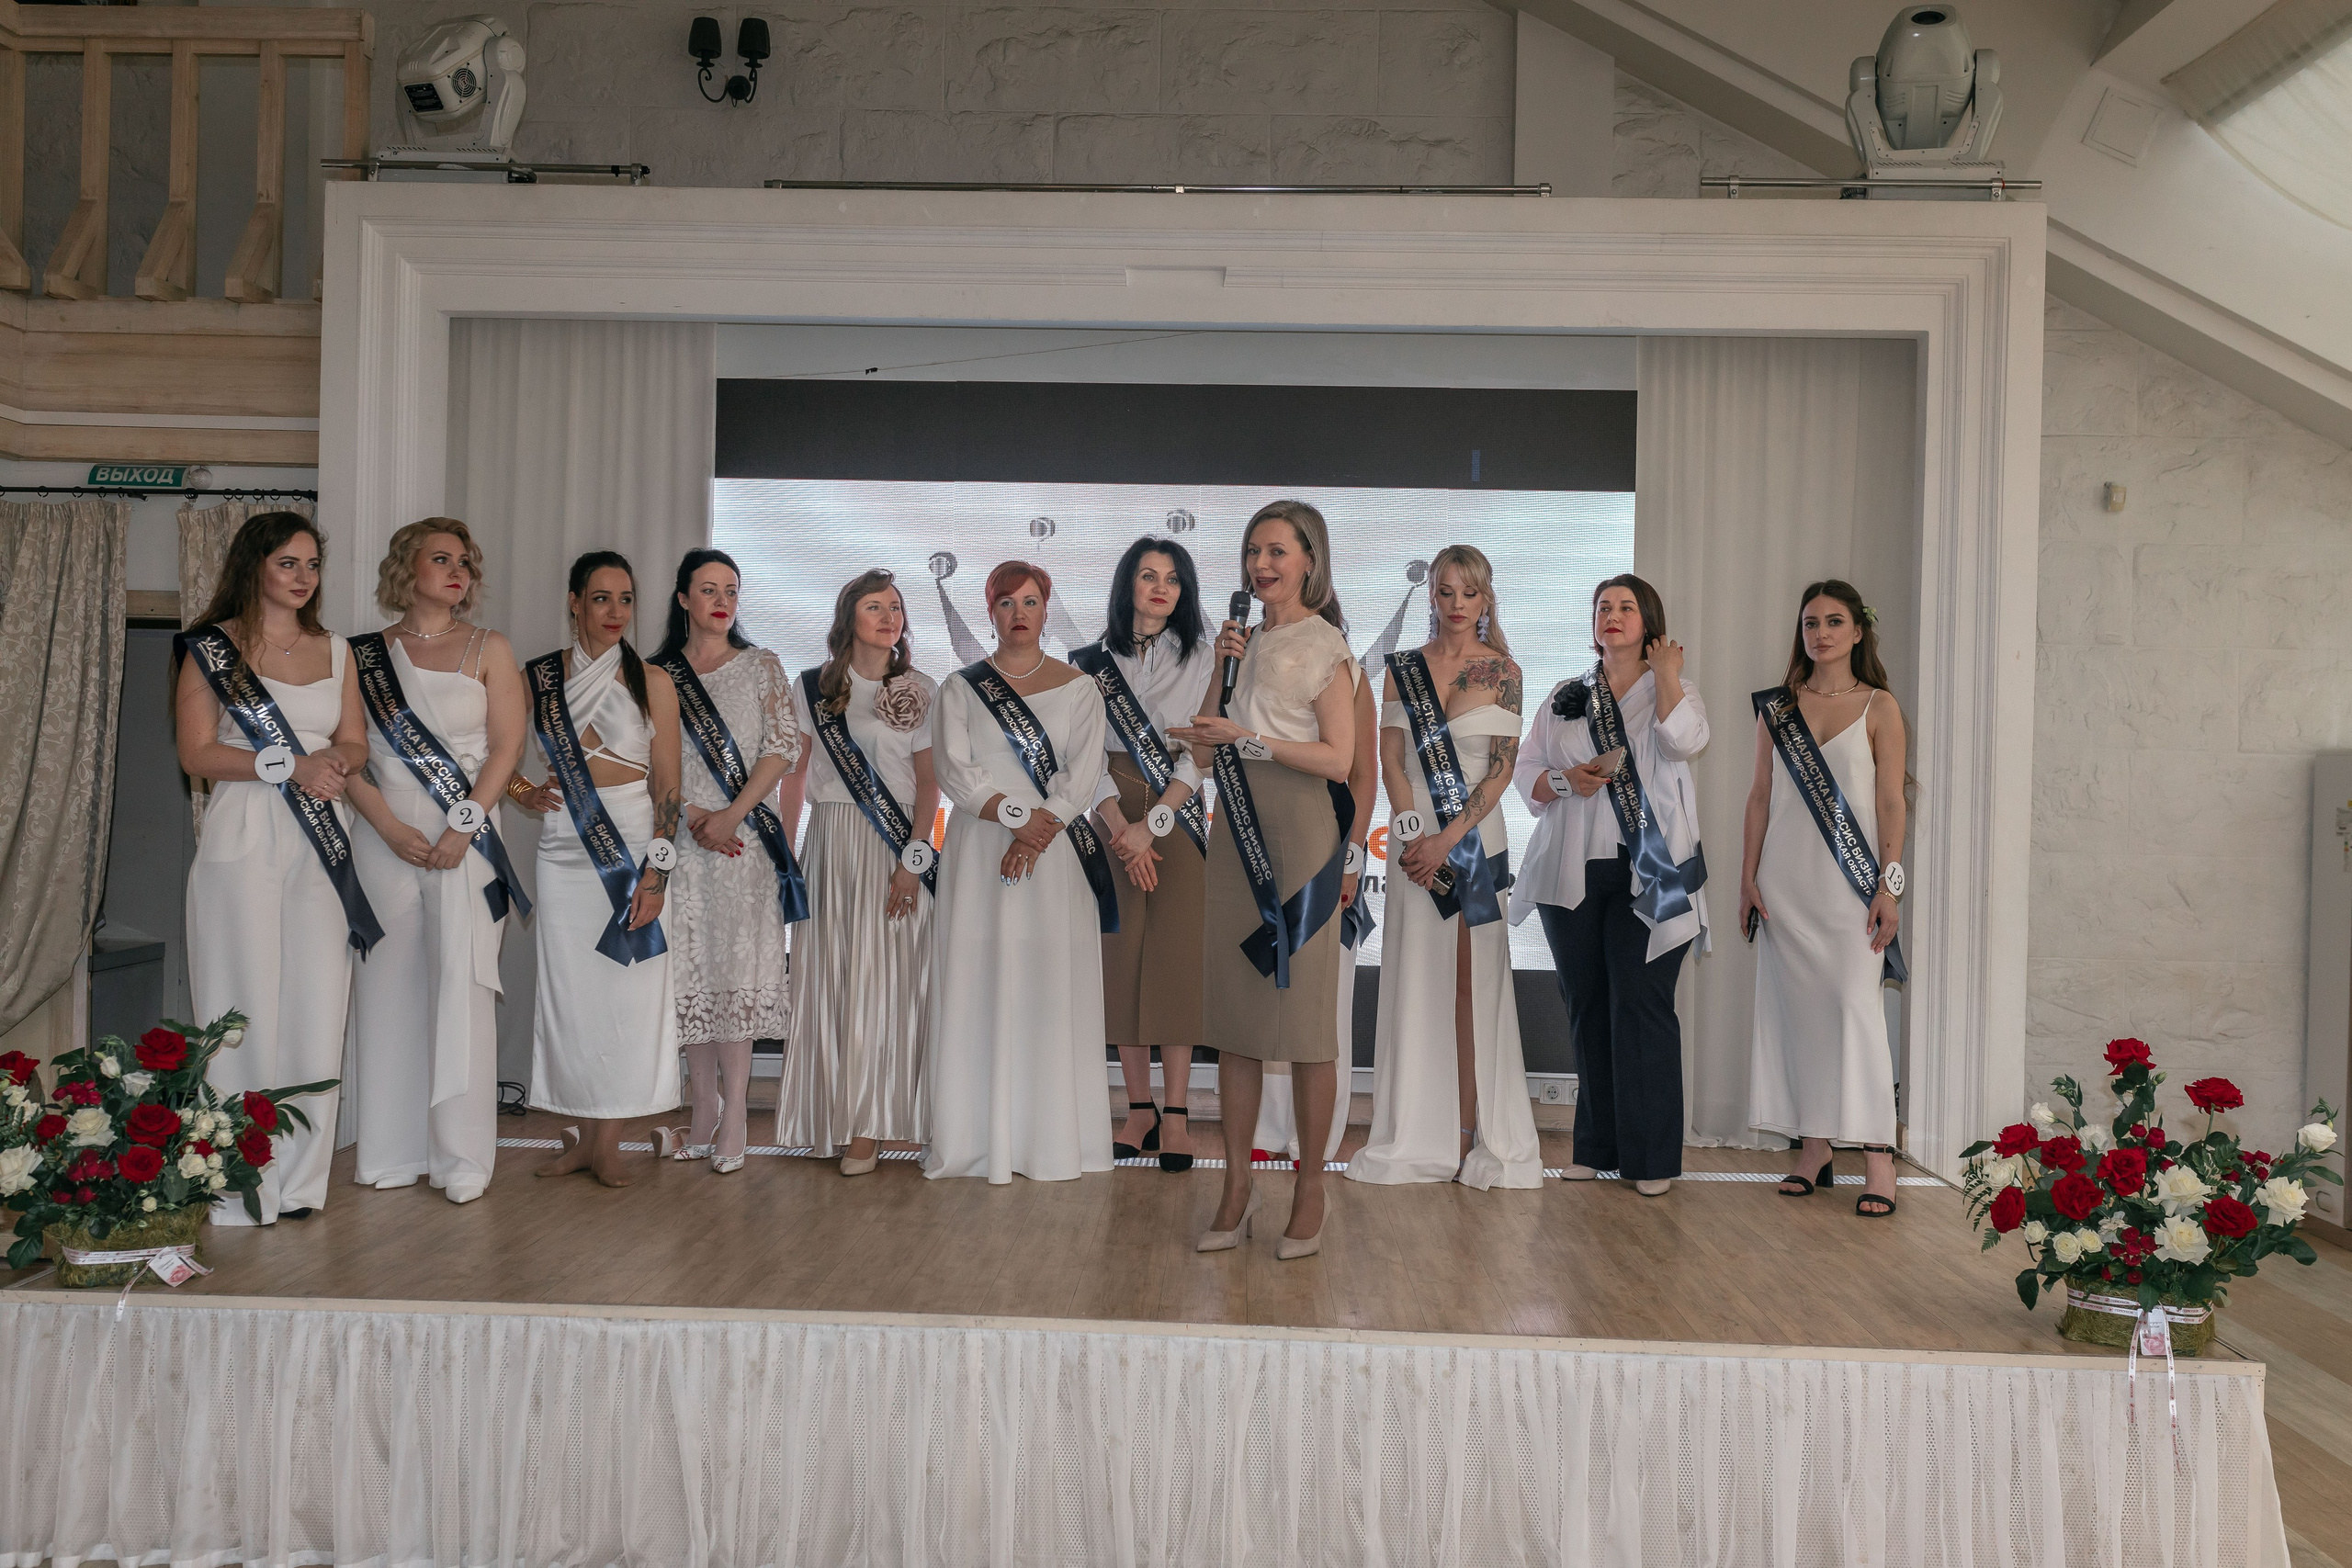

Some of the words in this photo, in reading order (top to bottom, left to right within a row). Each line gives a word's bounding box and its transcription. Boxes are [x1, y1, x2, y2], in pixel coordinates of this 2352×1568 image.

[96, 467, 175, 484] ВЫХОД
[363, 673, 396, 733] НОВОСИБИРСК
[399, 738, 457, 806] НОВОСИБИРСКАЯ
[374, 670, 421, 745] ФИНАЛИСТКА
[417, 742, 460, 792] МИССИС
[683, 682, 725, 749] ФИНАЛИСТКА
[996, 704, 1035, 760] НОВОСИБИРСК
[1006, 700, 1050, 773] ФИНАЛИСТКА
[1108, 699, 1144, 754] НОВОСИБИРСК
[1140, 751, 1148, 760] И
[1116, 695, 1162, 764] ФИНАЛИСТКА
[1400, 671, 1422, 717] НОВОСИБИРСК
[1419, 725, 1446, 797] НОВОСИБИРСКАЯ
[1410, 666, 1439, 734] ФИНАЛИСТКА
[1432, 735, 1455, 786] МИССИС
[1448, 787, 1463, 815] БИЗ
[265, 757, 286, 770] 1
[823, 728, 857, 784] НОВОСИБИРСК
[1242, 739, 1265, 758] 12
[1590, 685, 1601, 719] СИБИРСК
[1618, 795, 1635, 832] ОБЛАСТЬ
[831, 725, 876, 795] ФИНАЛИСТКА
[874, 794, 909, 838] МИССИС
[1549, 773, 1568, 793] 11
[1624, 782, 1647, 829] БИЗНЕС
[1788, 723, 1830, 797] ФИНАЛИСТКА
[1826, 796, 1856, 846] МИССИС
[1851, 847, 1876, 887] БИЗНЕ
[319, 810, 346, 860] БИЗНЕС
[459, 807, 473, 825] 2
[1155, 813, 1168, 828] 8
[1216, 755, 1248, 840] НОВОСИБИРСКАЯ
[1244, 840, 1264, 886] ОБЛАСТЬ
[1227, 764, 1250, 826] МИССИС
[1247, 827, 1272, 881] БИЗНЕС
[1396, 816, 1419, 836] 10
[1779, 727, 1811, 783] НОВОСИБИРСК
[1810, 790, 1850, 859] НОВОСИБИРСКАЯ
[1848, 859, 1871, 896] ОБЛАСТЬ
[315, 826, 338, 866] ОБЛАСТЬ
[590, 835, 613, 874] ОБЛАСТЬ
[594, 823, 626, 868] БИЗНЕС
[654, 846, 669, 862] 3
[912, 849, 923, 866] 5
[1343, 849, 1354, 865] 9
[1887, 866, 1902, 890] 13
